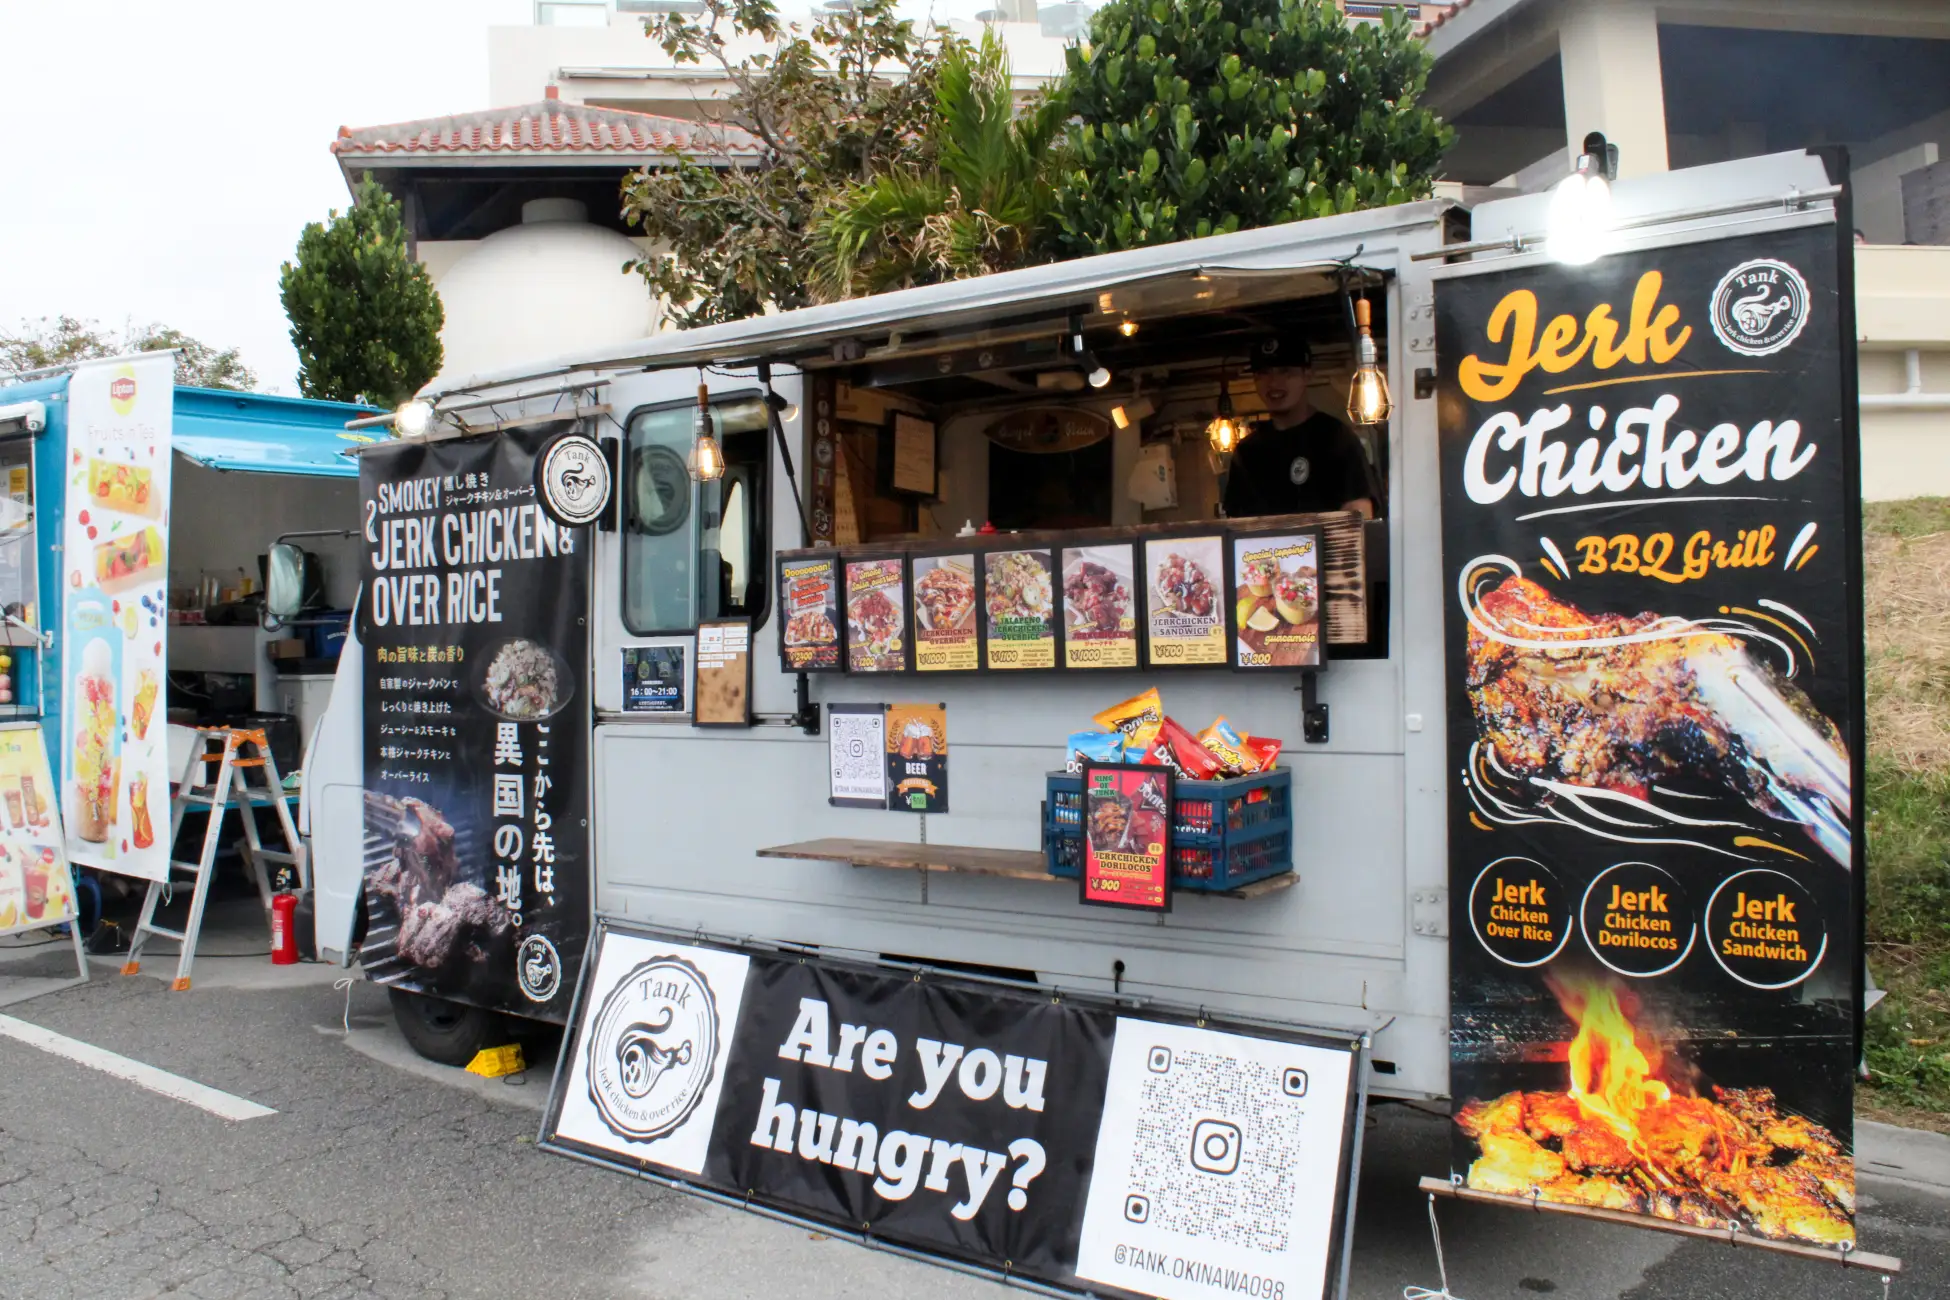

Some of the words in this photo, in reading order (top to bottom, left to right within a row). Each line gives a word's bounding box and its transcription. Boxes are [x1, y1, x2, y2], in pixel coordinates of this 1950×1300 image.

[1735, 269, 1780, 288] Tank
[1458, 270, 1693, 402] Jerk
[1736, 335, 1763, 345] chicken
[112, 384, 134, 396] Lipton
[564, 450, 592, 464] Tank
[1463, 393, 1818, 504] Chicken
[378, 476, 441, 514] SMOKEY
[445, 485, 536, 506] ジャークチキン&オーバーラ
[371, 516, 438, 571] JERK
[442, 504, 557, 566] CHICKEN
[1574, 532, 1688, 583] BBQ
[1684, 524, 1776, 579] Grill
[372, 574, 440, 627] OVER
[447, 569, 503, 624] RICE
[1153, 617, 1217, 626] JERKCHICKEN
[1159, 627, 1209, 636] SANDWICH
[1263, 632, 1317, 645] guacamole
[377, 645, 464, 663] 肉の旨味と炭の香り
[917, 651, 947, 665] ¥1000
[1070, 648, 1101, 662] ¥1000
[1154, 644, 1184, 658] ¥700
[381, 768, 430, 783] オーバーライス
[905, 762, 928, 775] BEER
[493, 722, 525, 928] 異国の地。
[1093, 852, 1159, 865] JERKCHICKEN
[1100, 860, 1152, 873] DORILOCOS
[1491, 877, 1546, 906] Jerk
[1606, 884, 1668, 913] Jerk
[1490, 905, 1549, 925] Chicken
[1731, 892, 1796, 923] Jerk
[1486, 922, 1520, 940] Over
[1522, 924, 1553, 942] Rice
[1604, 912, 1671, 932] Chicken
[1729, 921, 1799, 943] Chicken
[528, 942, 547, 955] Tank
[1598, 930, 1678, 951] Dorilocos
[1722, 938, 1808, 962] Sandwich
[639, 978, 693, 1010] Tank
[778, 996, 898, 1081] Are
[908, 1037, 1048, 1112] you
[610, 1088, 640, 1120] chicken
[640, 1110, 649, 1121] &
[649, 1105, 671, 1119] over
[671, 1088, 689, 1109] rice
[750, 1077, 1047, 1221] hungry?
[1113, 1243, 1285, 1300] @TANK.OKINAWA098
